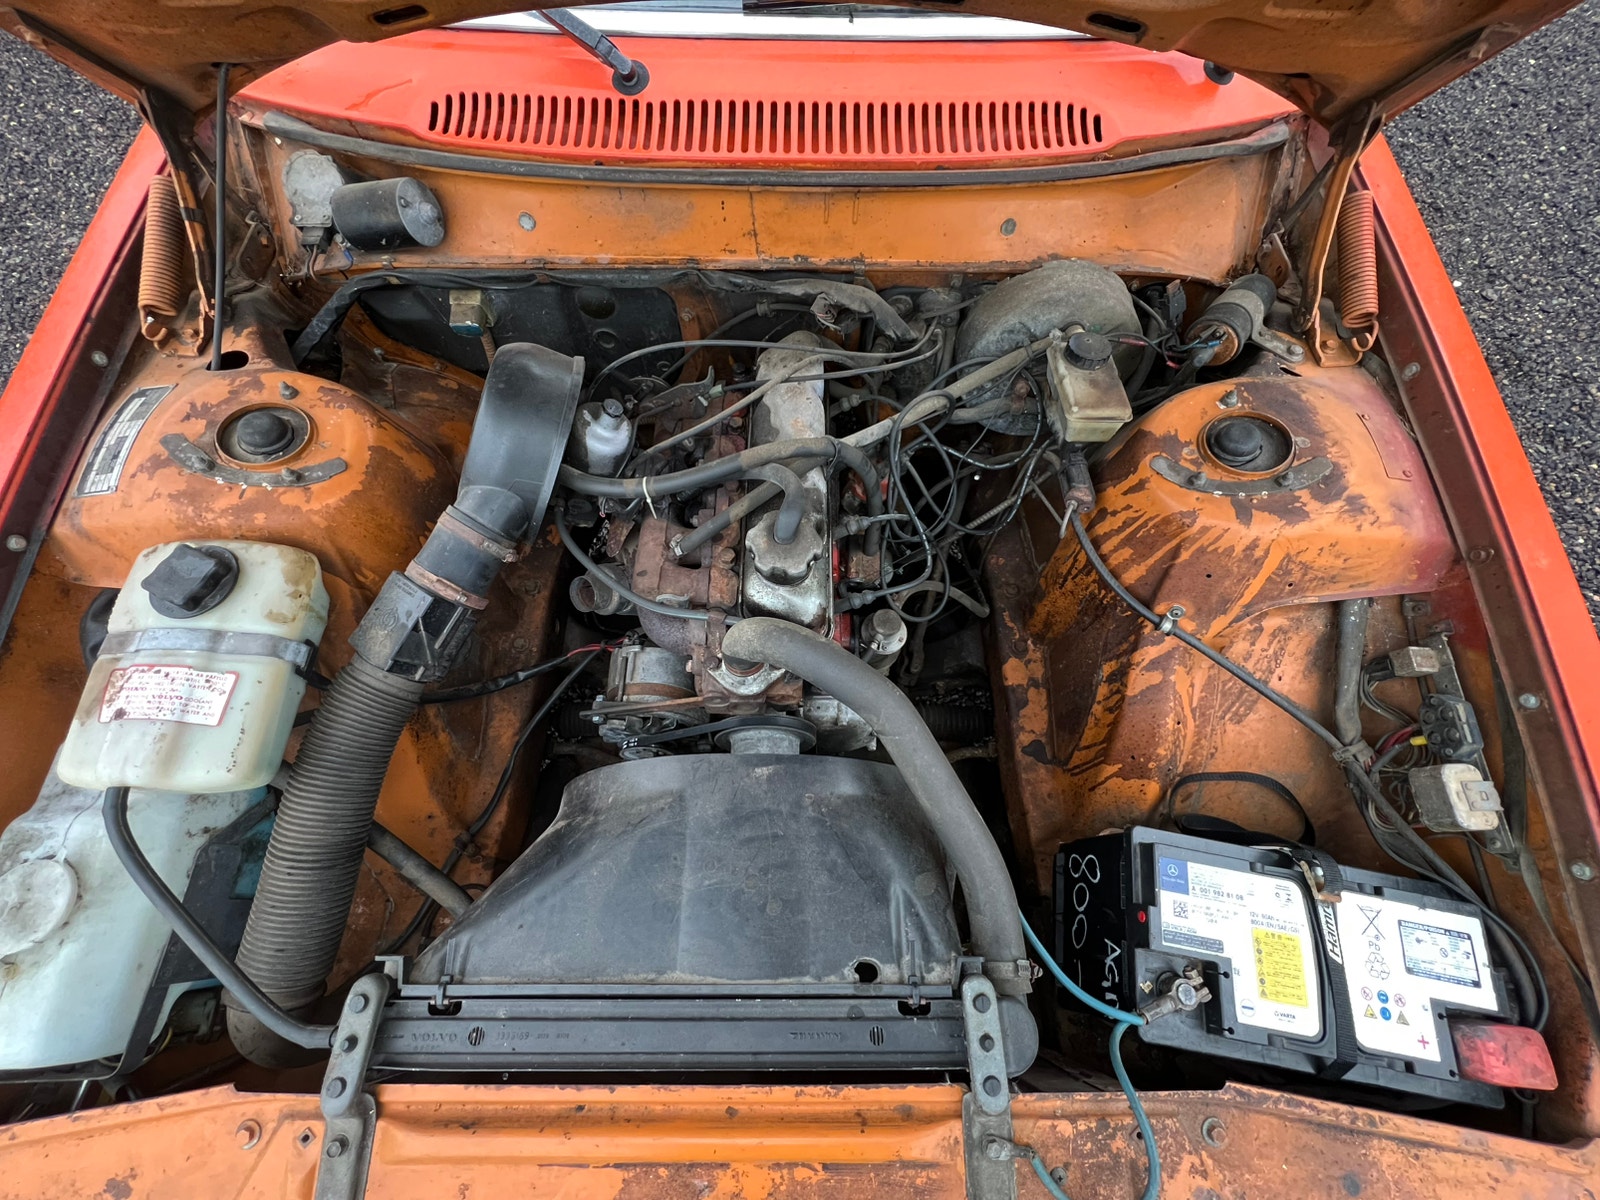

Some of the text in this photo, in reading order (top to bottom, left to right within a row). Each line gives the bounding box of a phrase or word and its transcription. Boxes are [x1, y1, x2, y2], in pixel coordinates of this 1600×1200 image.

[151, 694, 184, 702] VOLVO
[1069, 853, 1100, 949] 800
[1321, 903, 1340, 958] Hamr
[411, 1031, 457, 1043] VOLVO
